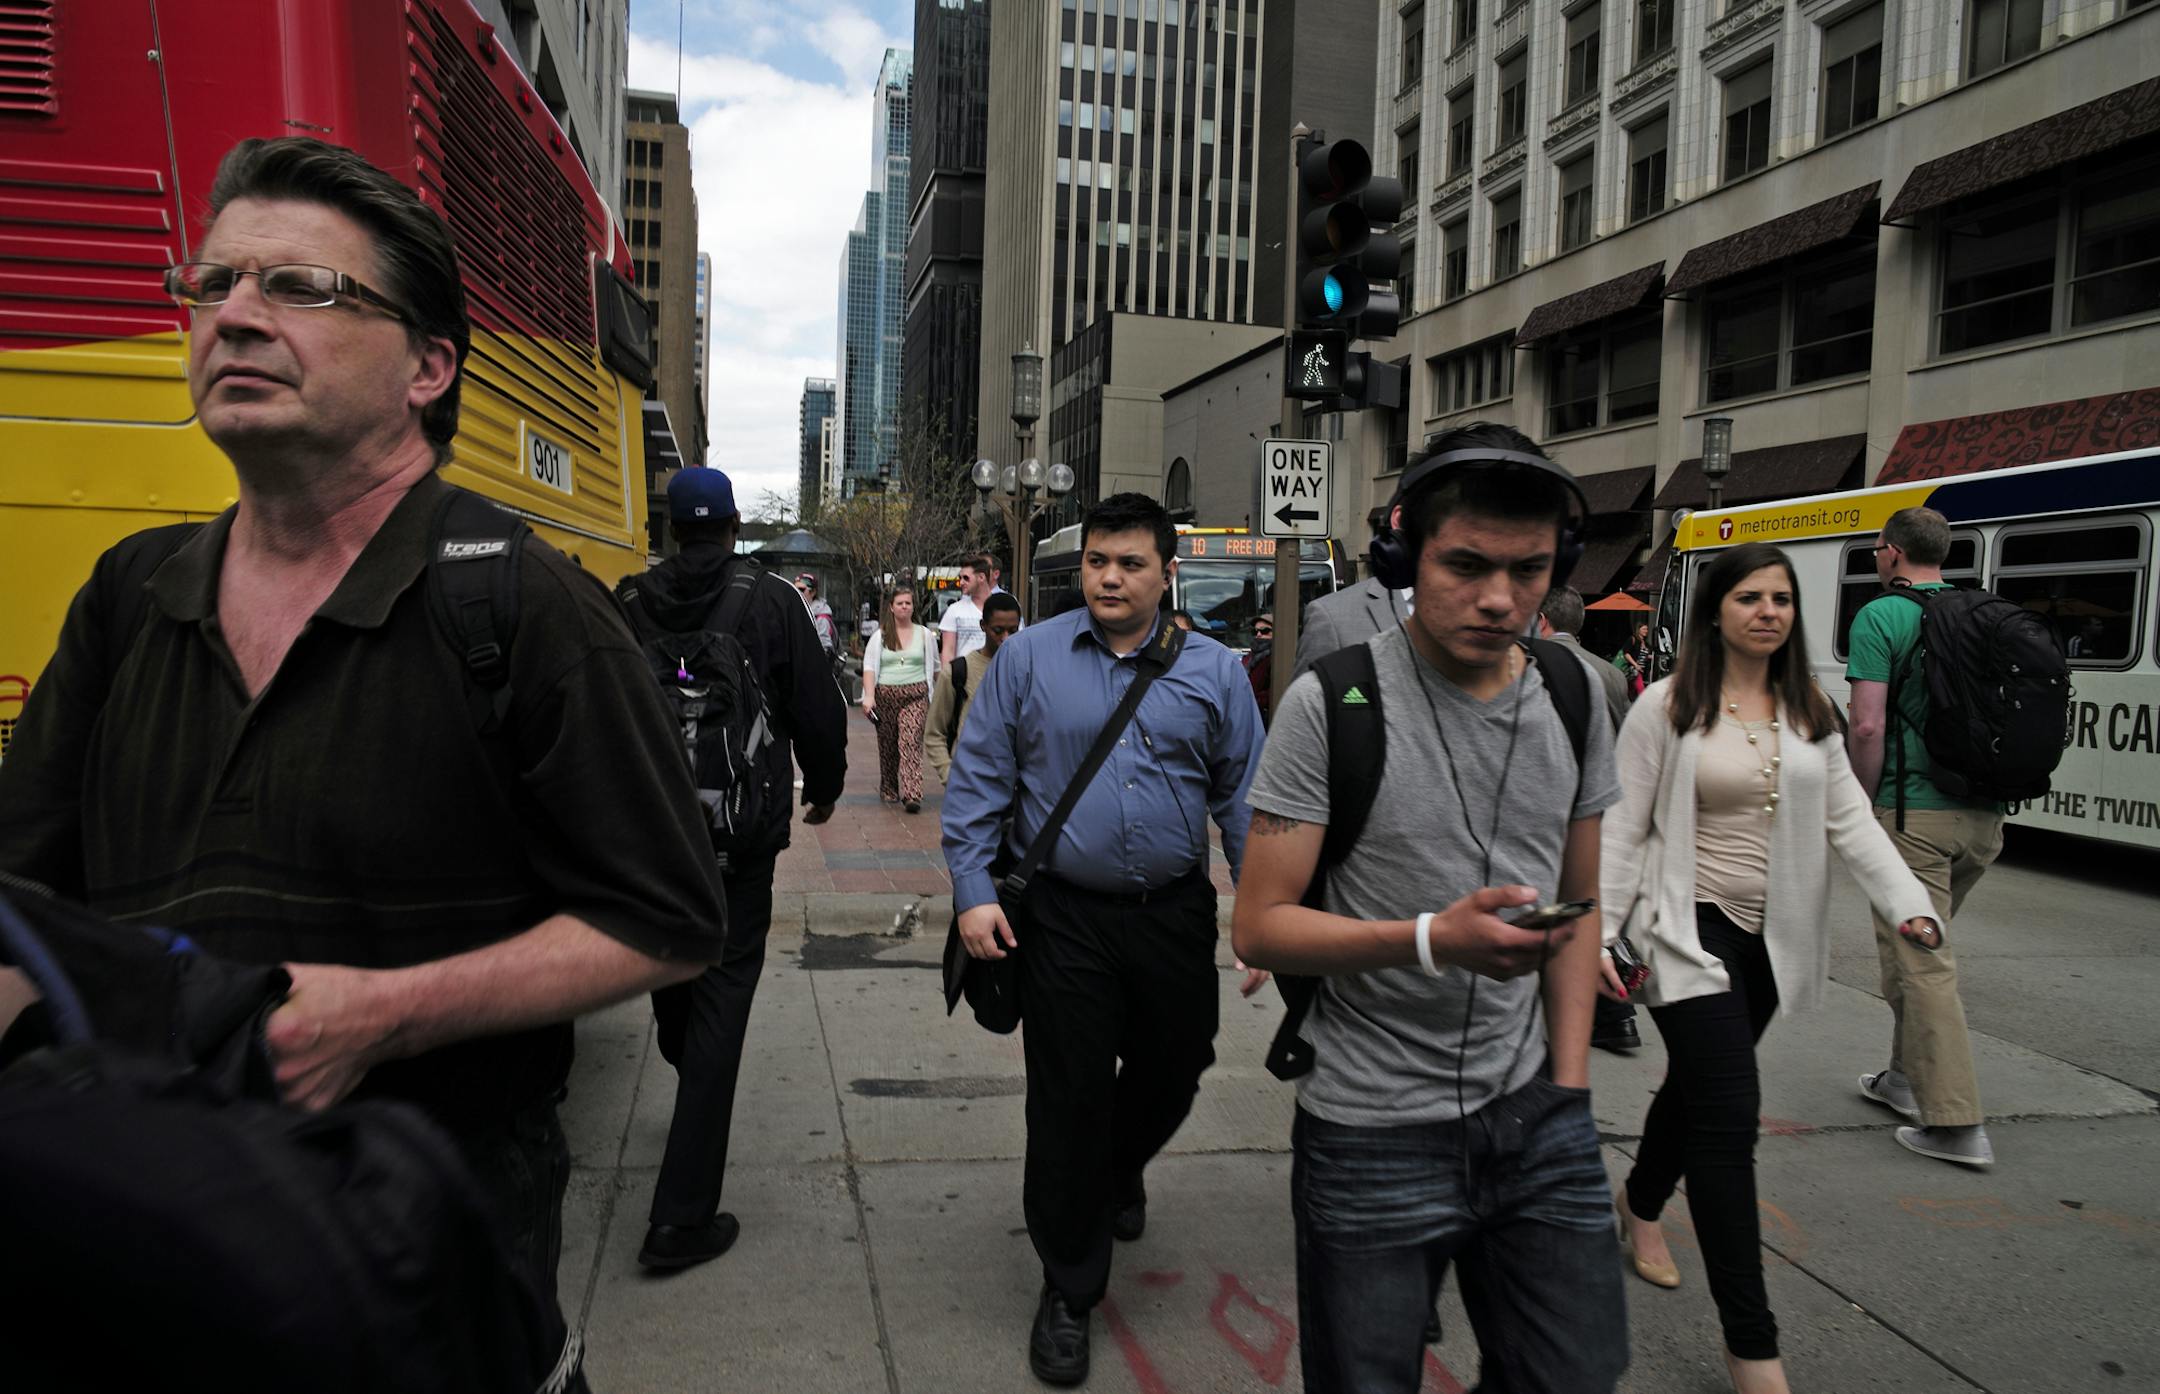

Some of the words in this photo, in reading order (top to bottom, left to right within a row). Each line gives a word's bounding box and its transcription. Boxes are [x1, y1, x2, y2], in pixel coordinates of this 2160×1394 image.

[534, 438, 560, 487] 901
[1272, 448, 1321, 471] ONE
[1271, 475, 1323, 498] WAY
[1740, 509, 1860, 533] metrotransit.org
[1191, 538, 1206, 555] 10
[1226, 540, 1252, 555] FREE
[2108, 703, 2160, 754] CA
[2042, 790, 2087, 819] THE
